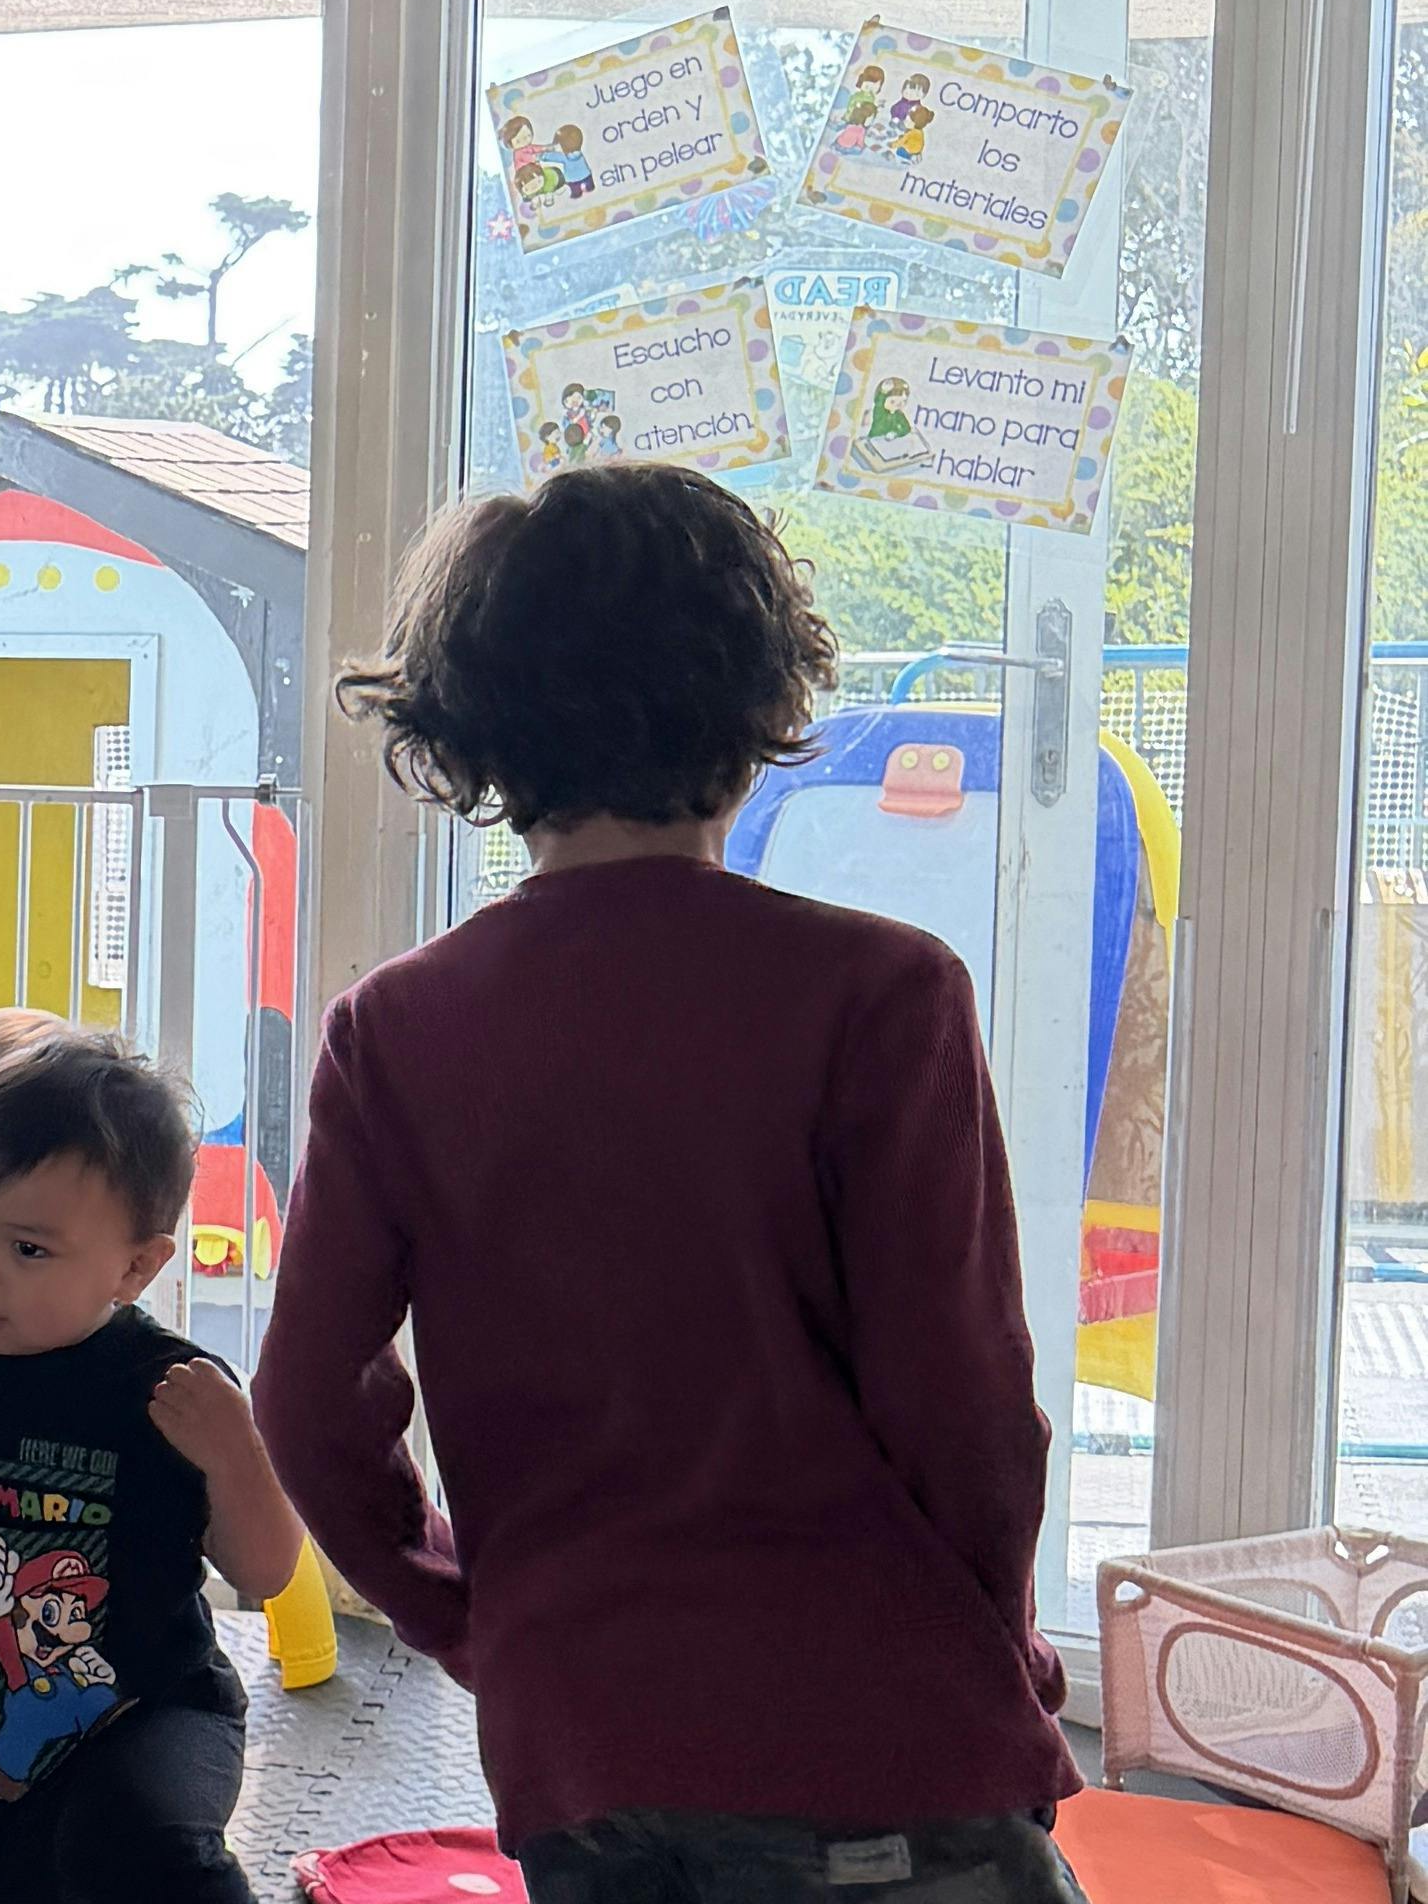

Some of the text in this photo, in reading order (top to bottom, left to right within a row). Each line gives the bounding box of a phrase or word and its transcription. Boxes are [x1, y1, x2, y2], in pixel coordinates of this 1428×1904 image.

[585, 53, 703, 110] Juego en
[601, 94, 703, 144] orden y
[938, 81, 1079, 141] Comparto
[599, 132, 724, 188] sin pelear
[977, 139, 1021, 174] los
[899, 171, 1048, 232] materiales
[613, 327, 732, 369] Escucho
[650, 377, 704, 404] con
[928, 357, 1087, 405] Levanto mi
[633, 410, 754, 453] atención
[912, 404, 1080, 452] mano para
[935, 449, 1035, 490] hablar
[62, 1444, 88, 1471] WE
